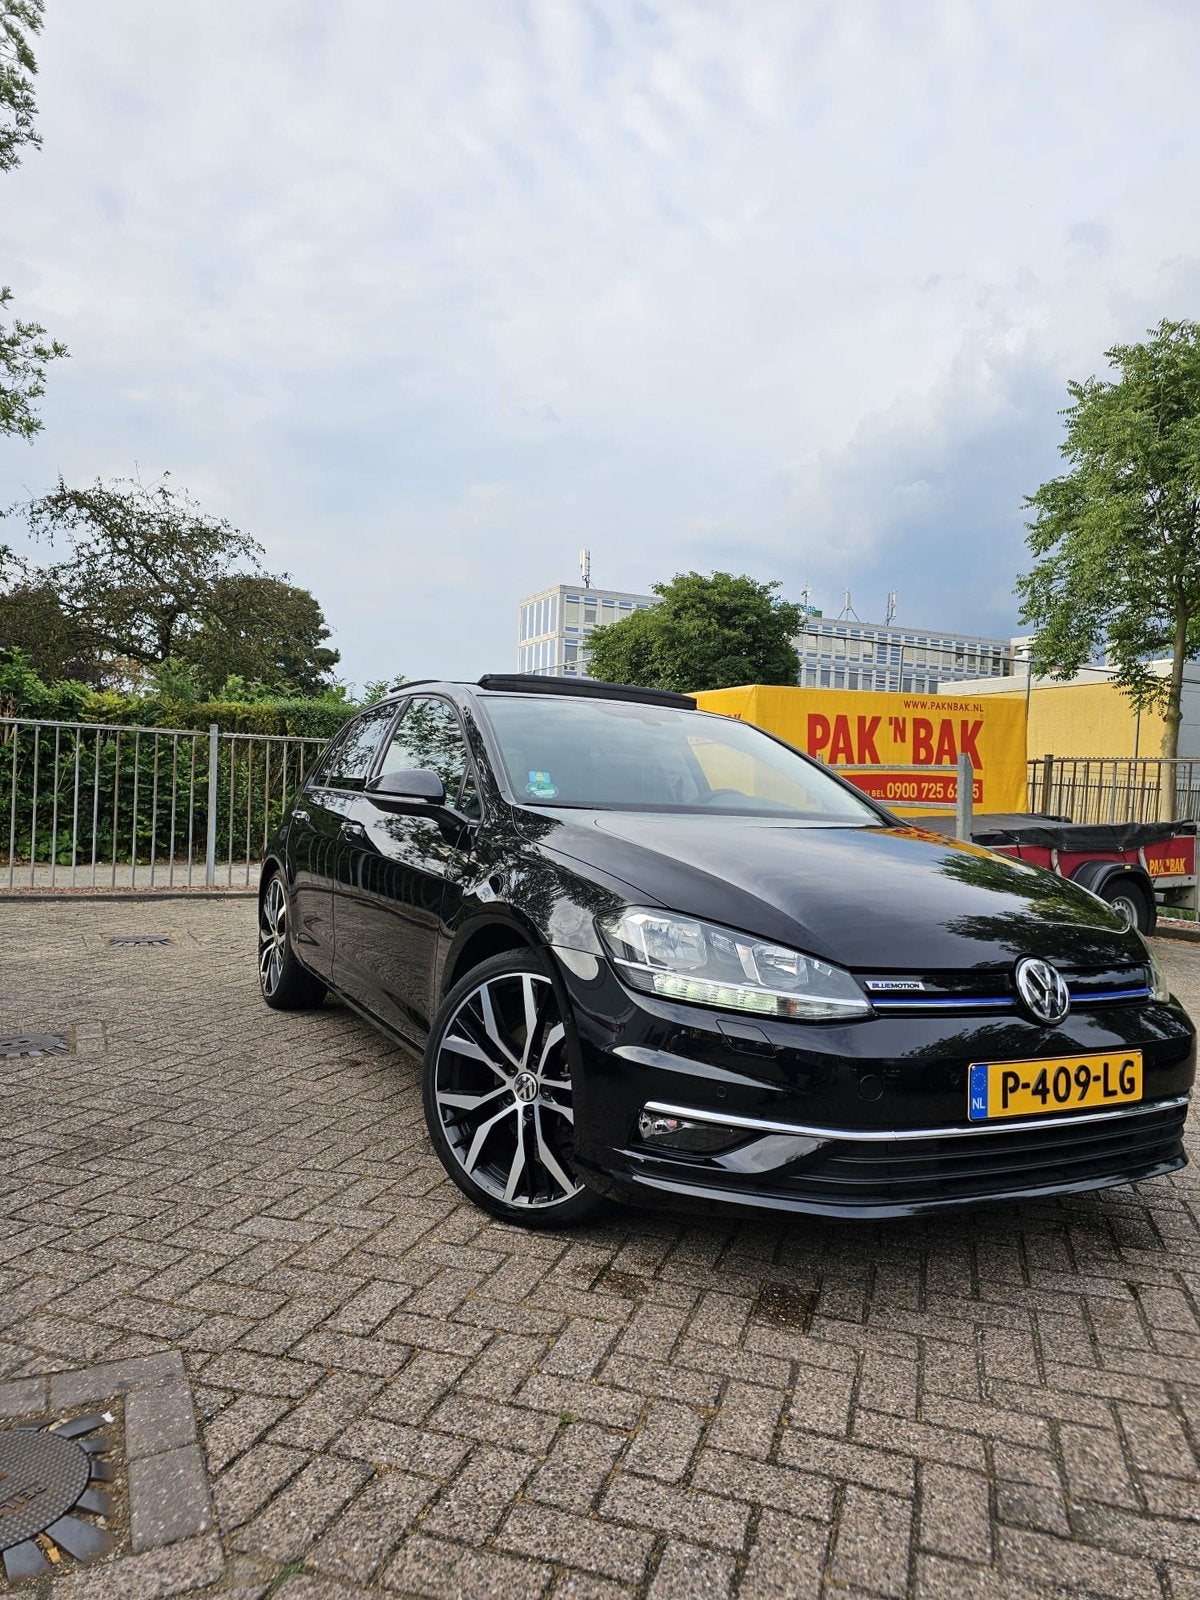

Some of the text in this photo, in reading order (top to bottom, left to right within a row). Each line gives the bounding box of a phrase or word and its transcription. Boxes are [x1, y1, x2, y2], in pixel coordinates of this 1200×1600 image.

[904, 700, 984, 713] WWW.PAKNBAK.NL
[807, 713, 882, 764] PAK
[912, 717, 984, 770] BAK
[871, 789, 886, 798] BEL
[886, 782, 918, 798] 0900
[921, 783, 944, 799] 725
[947, 783, 979, 799] 65
[1170, 857, 1186, 872] BAK
[1001, 1059, 1136, 1110] P-409-LG
[972, 1097, 986, 1110] NL
